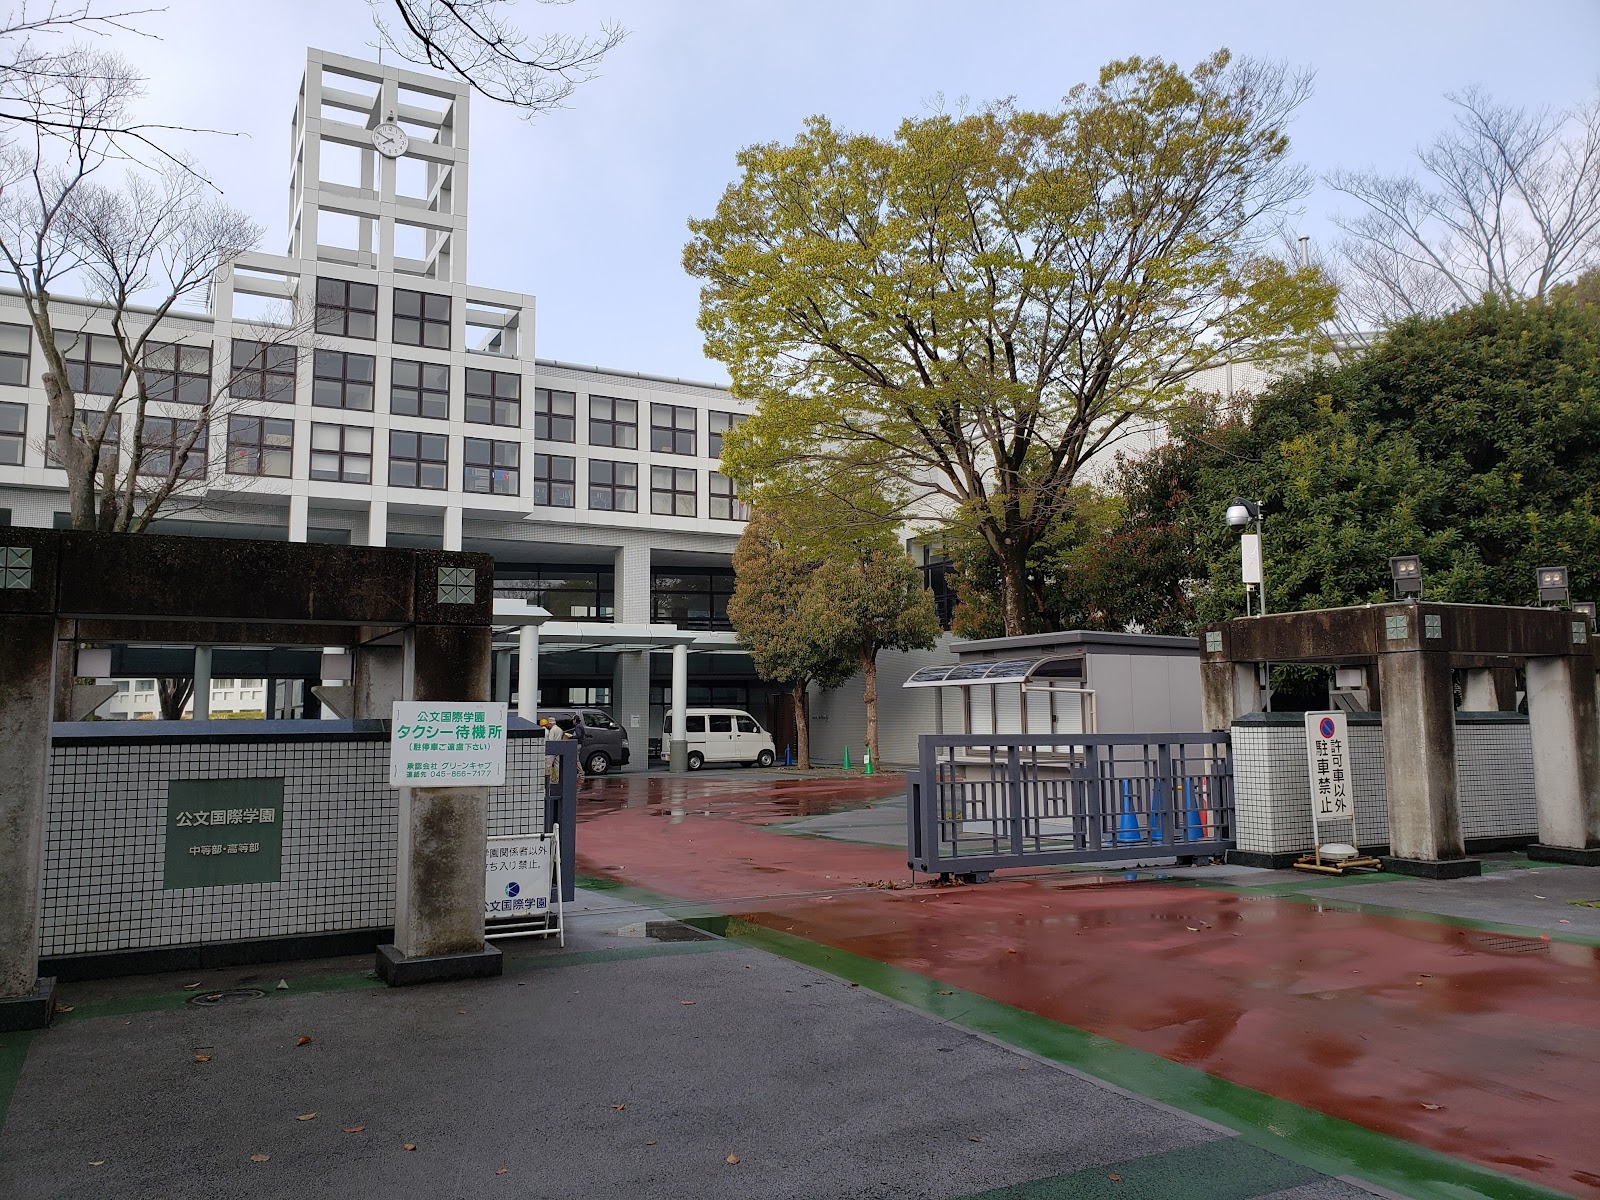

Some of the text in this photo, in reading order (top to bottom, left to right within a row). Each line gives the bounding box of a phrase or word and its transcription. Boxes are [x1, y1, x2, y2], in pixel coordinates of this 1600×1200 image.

[417, 711, 485, 723] 公文国際学園
[397, 724, 503, 740] タクシー待機所
[1315, 740, 1333, 814] 駐車禁止
[1330, 739, 1347, 813] 許可車以外
[175, 807, 276, 828] 公文国際学園
[189, 842, 260, 857] 中等部・高等部
